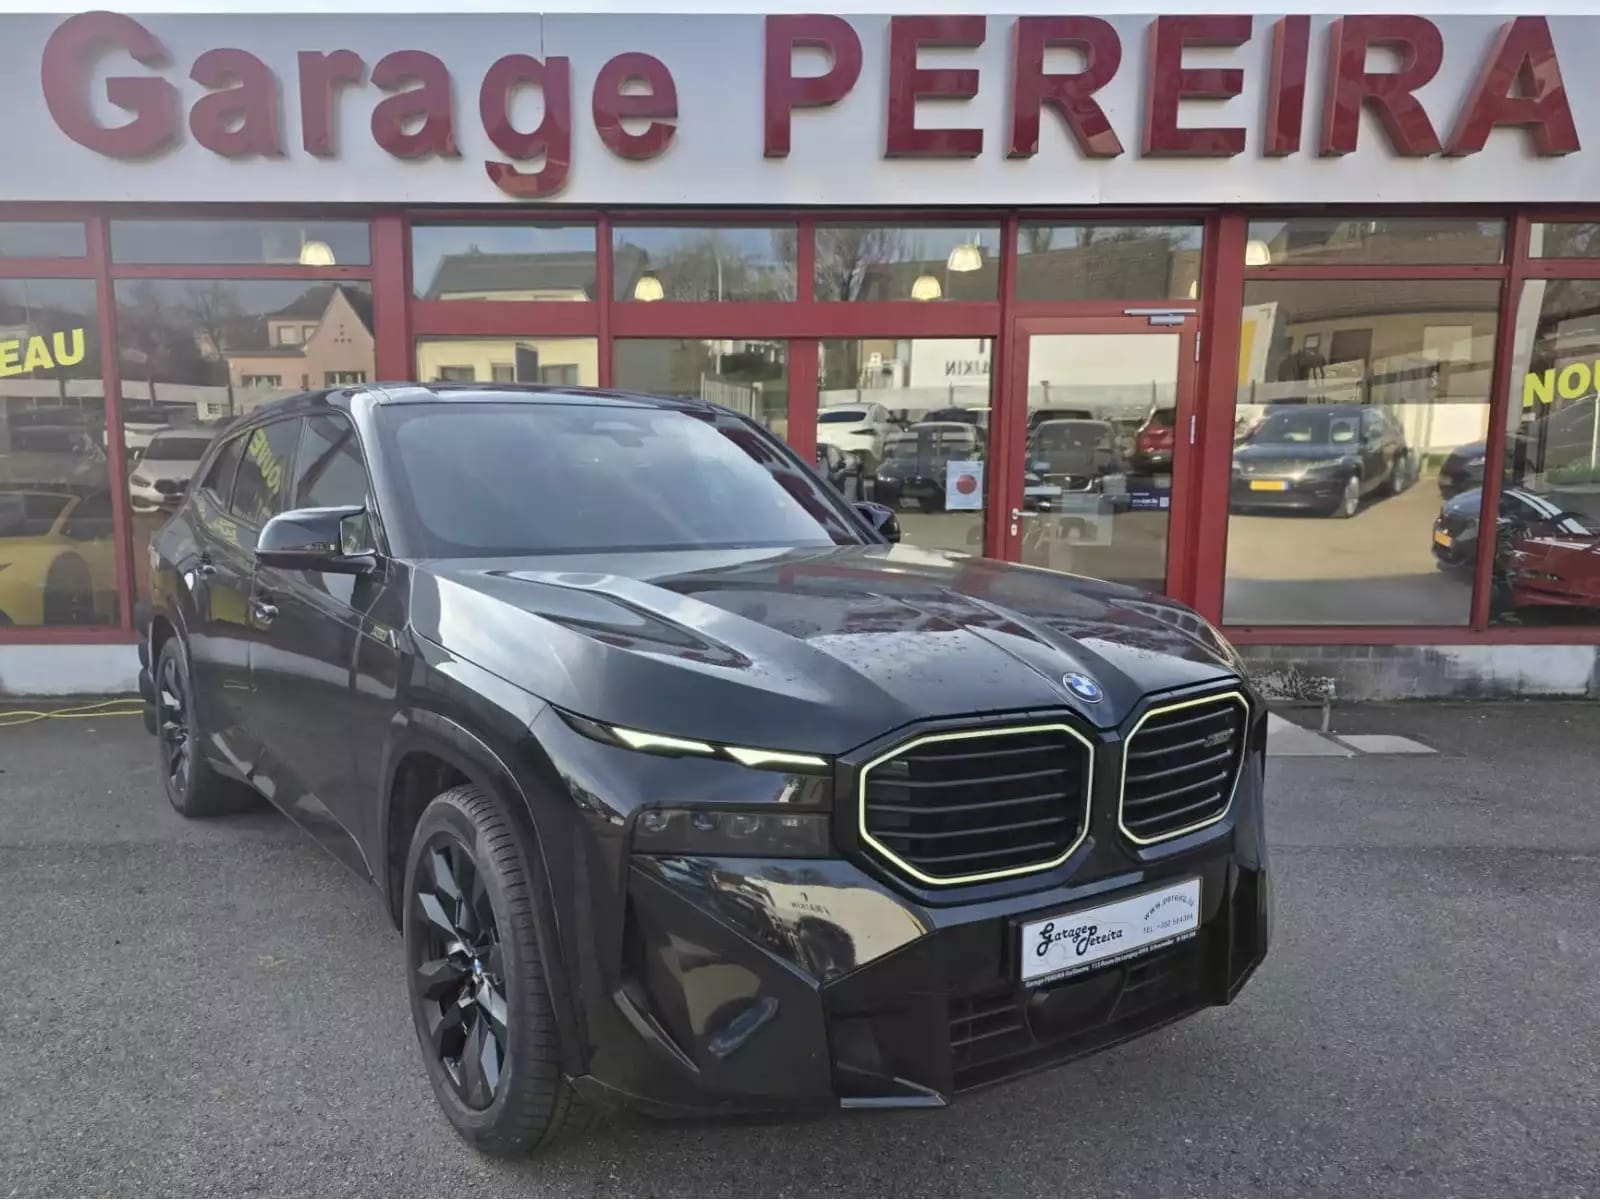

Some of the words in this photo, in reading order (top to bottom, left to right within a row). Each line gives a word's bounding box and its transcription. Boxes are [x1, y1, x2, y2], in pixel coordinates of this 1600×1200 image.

[41, 10, 678, 197] Garage
[763, 14, 1581, 158] PEREIRA
[0, 328, 85, 377] EAU
[1036, 922, 1087, 956] Garage
[1076, 925, 1123, 956] Pereira
